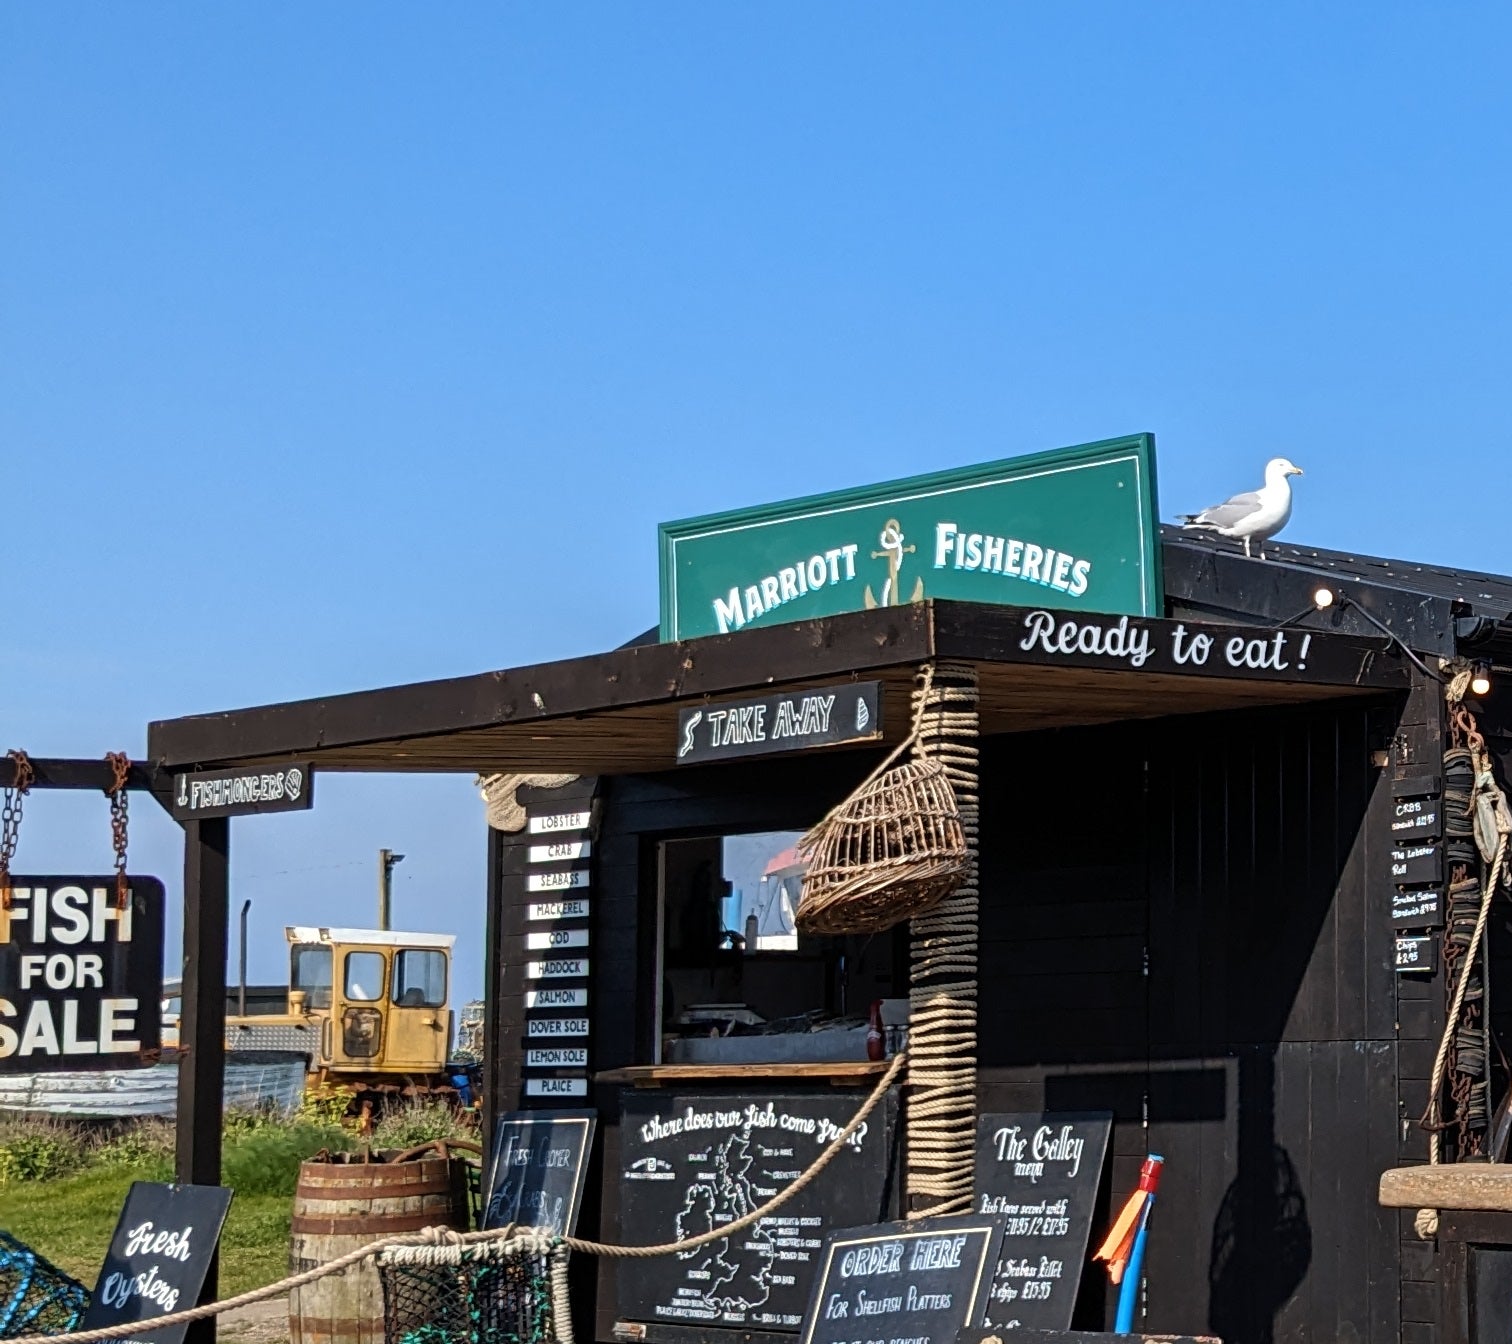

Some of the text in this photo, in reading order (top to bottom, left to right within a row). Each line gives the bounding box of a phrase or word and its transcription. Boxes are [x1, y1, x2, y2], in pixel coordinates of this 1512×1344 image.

[713, 522, 1091, 634] MARRIOTT FISHERIES
[1019, 610, 1155, 668] Ready
[1171, 624, 1214, 665] to
[1226, 631, 1289, 671] eat
[708, 695, 836, 747] TAKE AWAY
[190, 772, 284, 809] FISHMONGERS
[541, 814, 581, 830] LOBSTER
[547, 843, 573, 857] CRAB
[540, 873, 579, 886] SEABASS
[0, 886, 132, 944] FISH
[536, 902, 584, 916] MACKEREL
[549, 931, 570, 945] COD
[19, 954, 104, 989] FOR
[538, 960, 581, 974] HADDOCK
[539, 991, 576, 1004] SALMON
[530, 1020, 587, 1034] DOVER SOLE
[530, 1050, 585, 1063] LEMON SOLE
[541, 1080, 572, 1092] PLAICE
[642, 1115, 683, 1142] Where
[684, 1107, 713, 1131] does
[715, 1110, 744, 1128] our
[744, 1102, 777, 1132] fish
[780, 1114, 816, 1134] come
[994, 1125, 1085, 1178] The Galley
[126, 1221, 193, 1262] Fresh
[841, 1236, 966, 1278] ORDER HERE
[102, 1265, 180, 1312] Oysters
